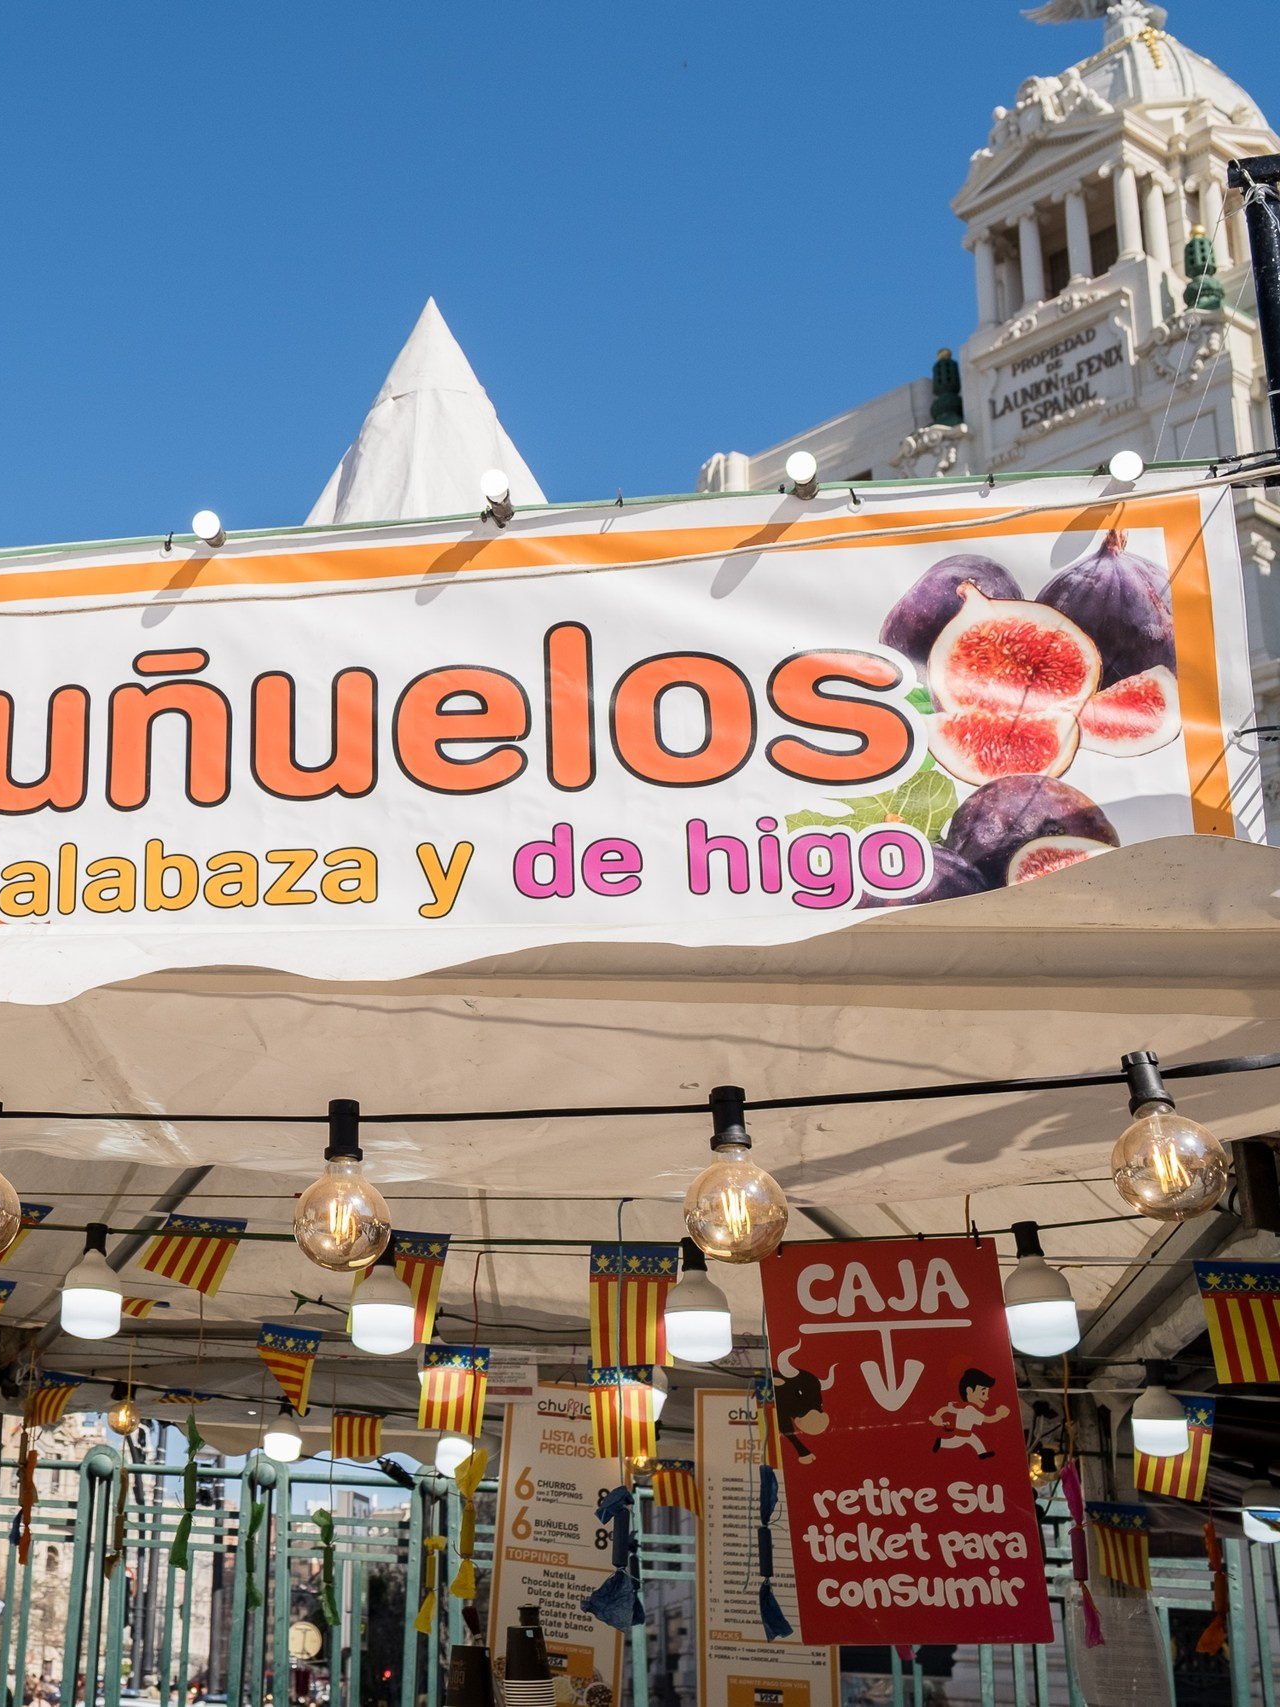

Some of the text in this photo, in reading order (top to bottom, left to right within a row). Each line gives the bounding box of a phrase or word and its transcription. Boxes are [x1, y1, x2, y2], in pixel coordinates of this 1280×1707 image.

[1012, 327, 1096, 378] PROPIEDAD
[1046, 359, 1063, 373] DE
[989, 395, 1014, 420] LA
[416, 841, 474, 919] y
[514, 823, 644, 899] de
[686, 815, 927, 910] higo
[797, 1258, 970, 1317] CAJA
[543, 1429, 594, 1445] LISTA de
[540, 1442, 596, 1459] PRECIOS
[736, 1439, 761, 1450] LIST
[515, 1467, 534, 1500] 6
[537, 1480, 576, 1491] CHURROS
[550, 1490, 583, 1500] TOPPINGS
[813, 1477, 938, 1517] retire
[512, 1506, 532, 1540] 6
[534, 1519, 579, 1532] BUÑUELOS
[802, 1522, 1028, 1568] ticket para
[508, 1548, 566, 1564] TOPPINGS
[543, 1569, 575, 1580] Nutella
[521, 1576, 565, 1589] Chocolate
[817, 1566, 1025, 1609] consumir
[527, 1587, 551, 1597] Dulce
[554, 1590, 565, 1599] de
[539, 1598, 576, 1610] Pistacho
[570, 1611, 592, 1622] fresa
[564, 1621, 593, 1632] blanco
[545, 1628, 569, 1639] Lotus
[711, 1630, 740, 1641] PACKS
[760, 1693, 779, 1703] VISA
